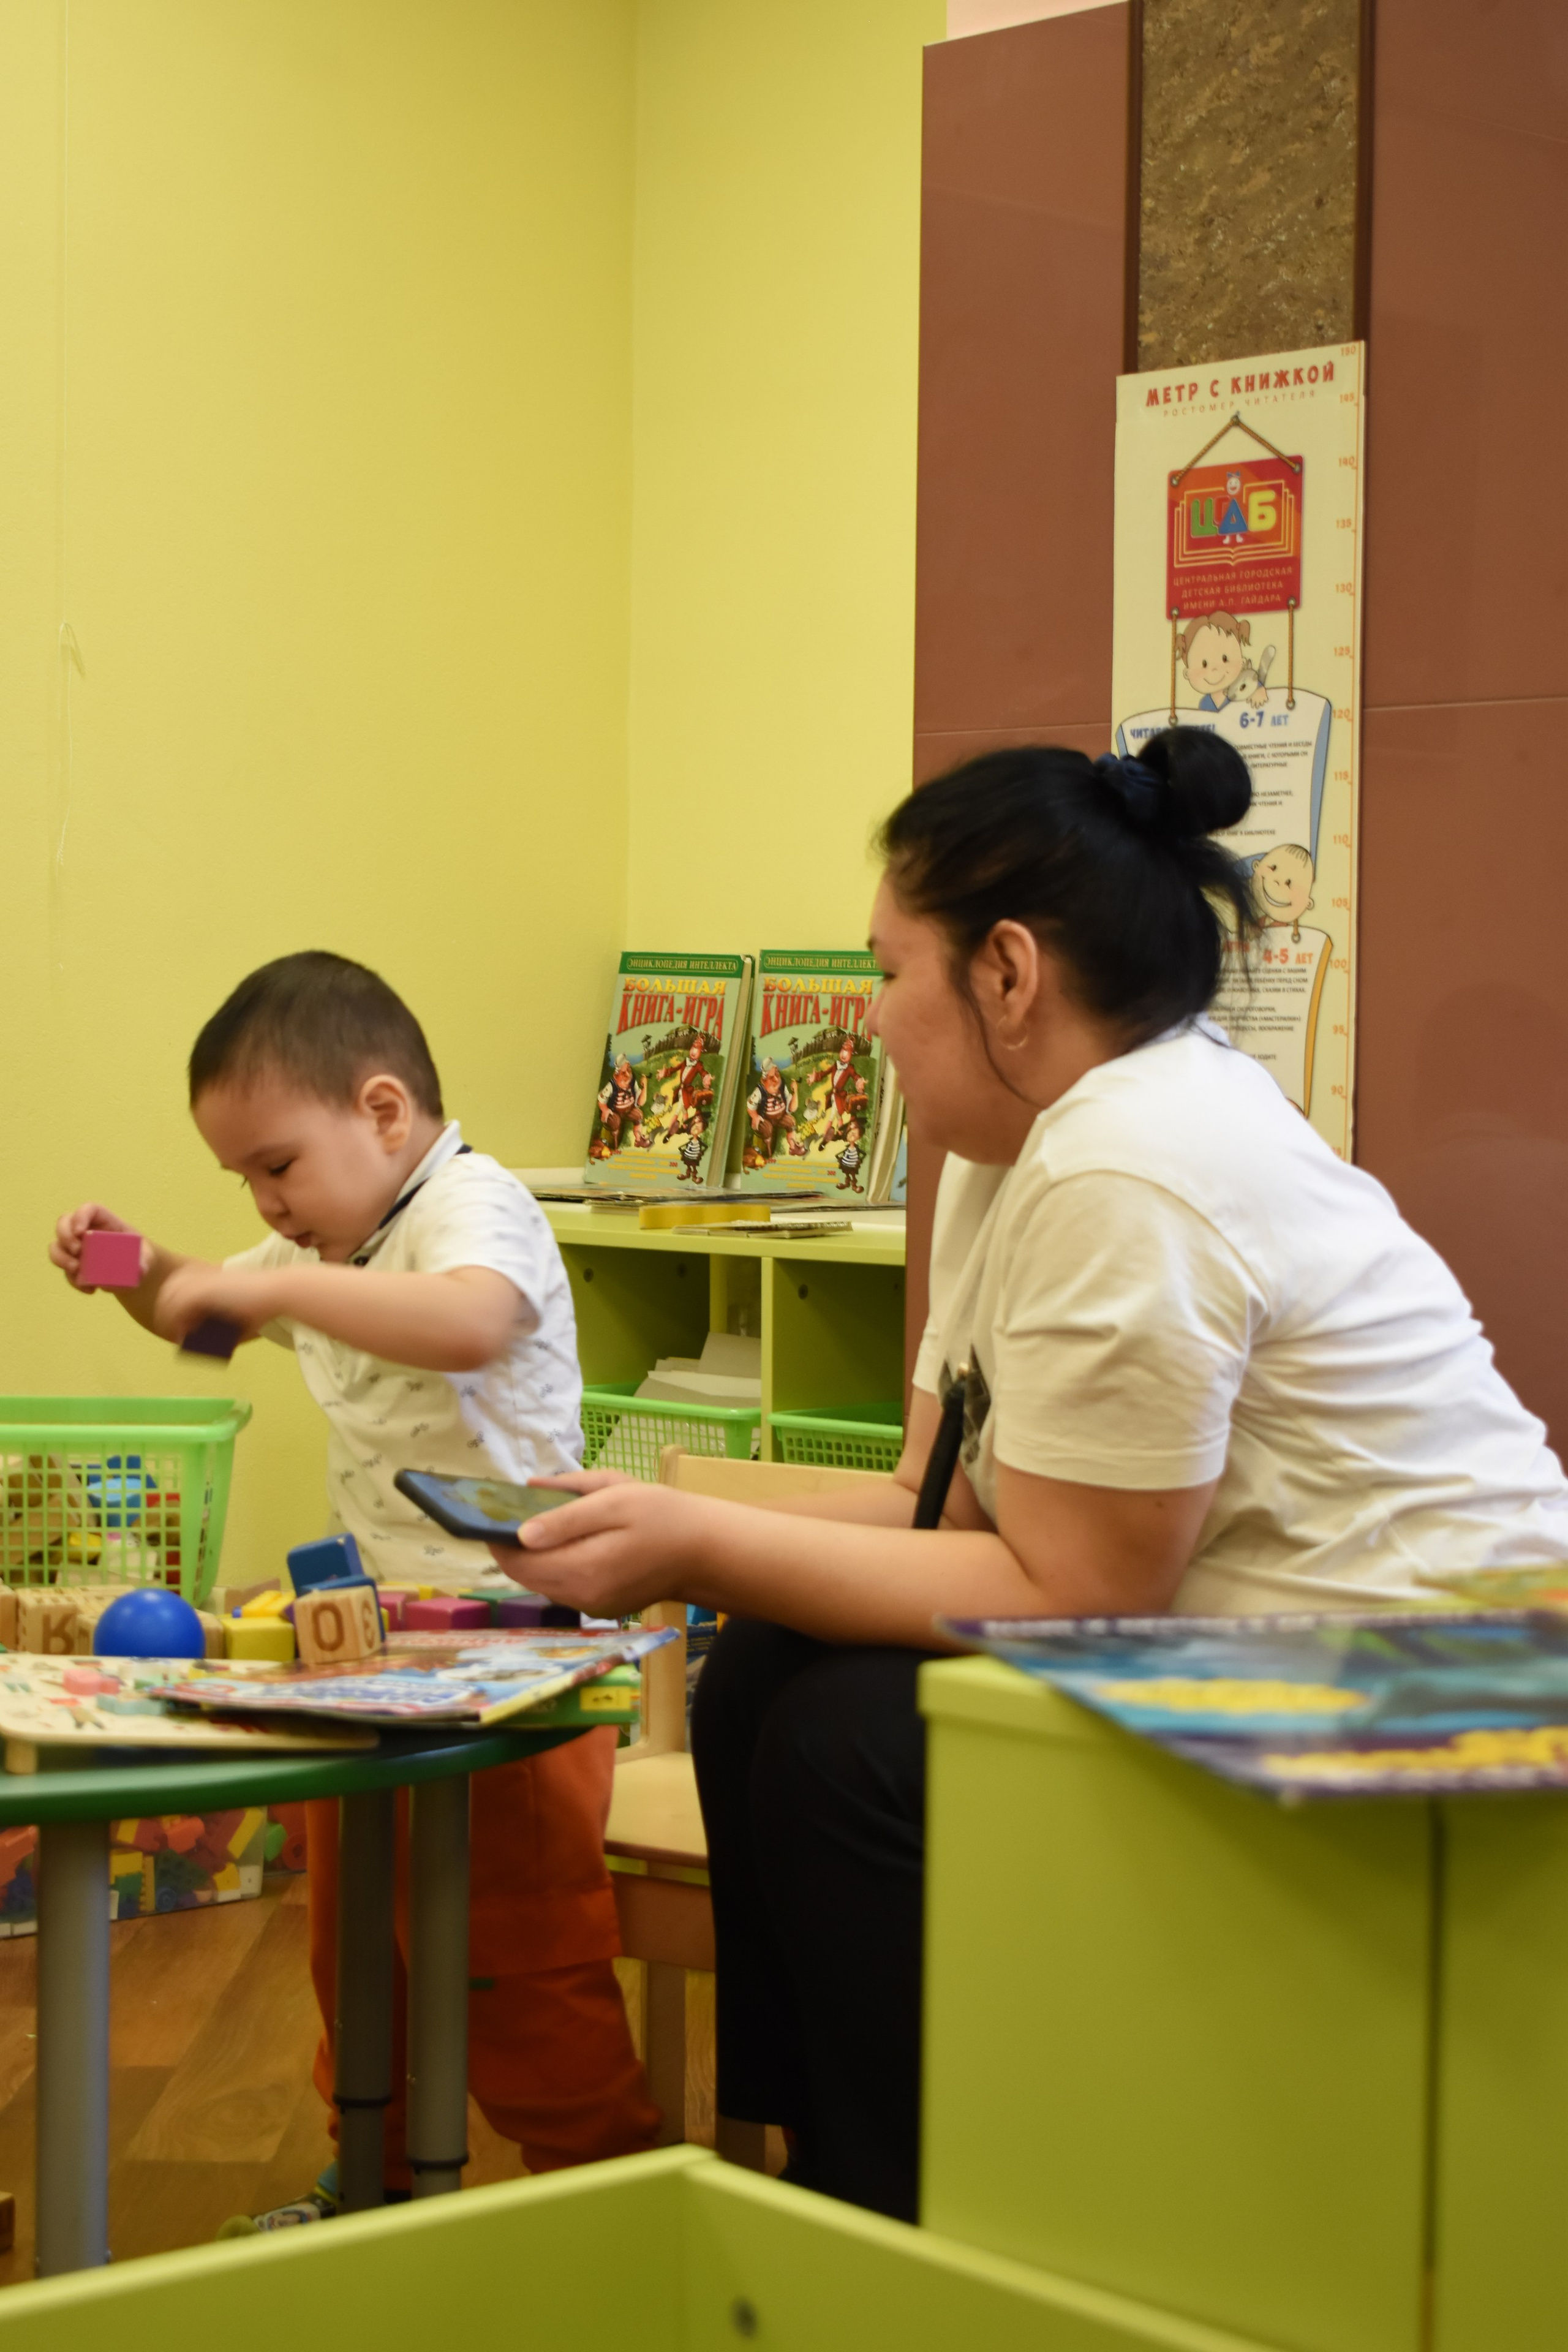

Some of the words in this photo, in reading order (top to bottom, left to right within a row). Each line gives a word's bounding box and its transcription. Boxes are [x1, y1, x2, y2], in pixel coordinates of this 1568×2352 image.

[1145, 382, 1198, 407] МЕТР
[1210, 379, 1219, 398] С
[1231, 361, 1335, 395] КНИЖКОЙ
[1164, 401, 1235, 418] РОСТОМЕР
[1244, 389, 1315, 406] ЧИТАТЕЛЯ
[1336, 519, 1351, 529] 135
[1173, 571, 1236, 586] ЦЕНТРАЛЬНАЯ
[1240, 566, 1292, 579] ГОРОДСКАЯ
[1182, 586, 1221, 598] ДЕТСКАЯ
[1224, 580, 1283, 594] БИБЛИОТЕКА
[1335, 583, 1352, 593] 130
[1183, 600, 1215, 610] ИМЕНИ
[1241, 594, 1281, 605] ГАЙДАРА
[1333, 646, 1351, 657] 125
[1239, 710, 1264, 729] 6-7
[1270, 714, 1289, 727] ЛЕТ
[1333, 709, 1351, 719] 120
[1334, 771, 1349, 781] 115
[1333, 835, 1349, 845] 110
[1332, 897, 1348, 908] 105
[766, 957, 829, 968] ЭНЦИКЛОПЕДИЯ
[831, 959, 878, 969] ИНТЕЛЛЕКТ
[1262, 948, 1289, 965] 4-5
[1295, 952, 1313, 965] ЛЕТ
[628, 958, 688, 969] ЭНЦИКЛОПЕДИЯ
[689, 960, 736, 971] ИНТЕЛЛЕКТА
[1330, 959, 1347, 969] 100
[623, 977, 726, 995] БОЛЬШАЯ
[763, 976, 873, 995] БОЛЬШАЯ
[616, 993, 725, 1041] КНИГА-ИГРА
[1331, 1085, 1343, 1095] 90
